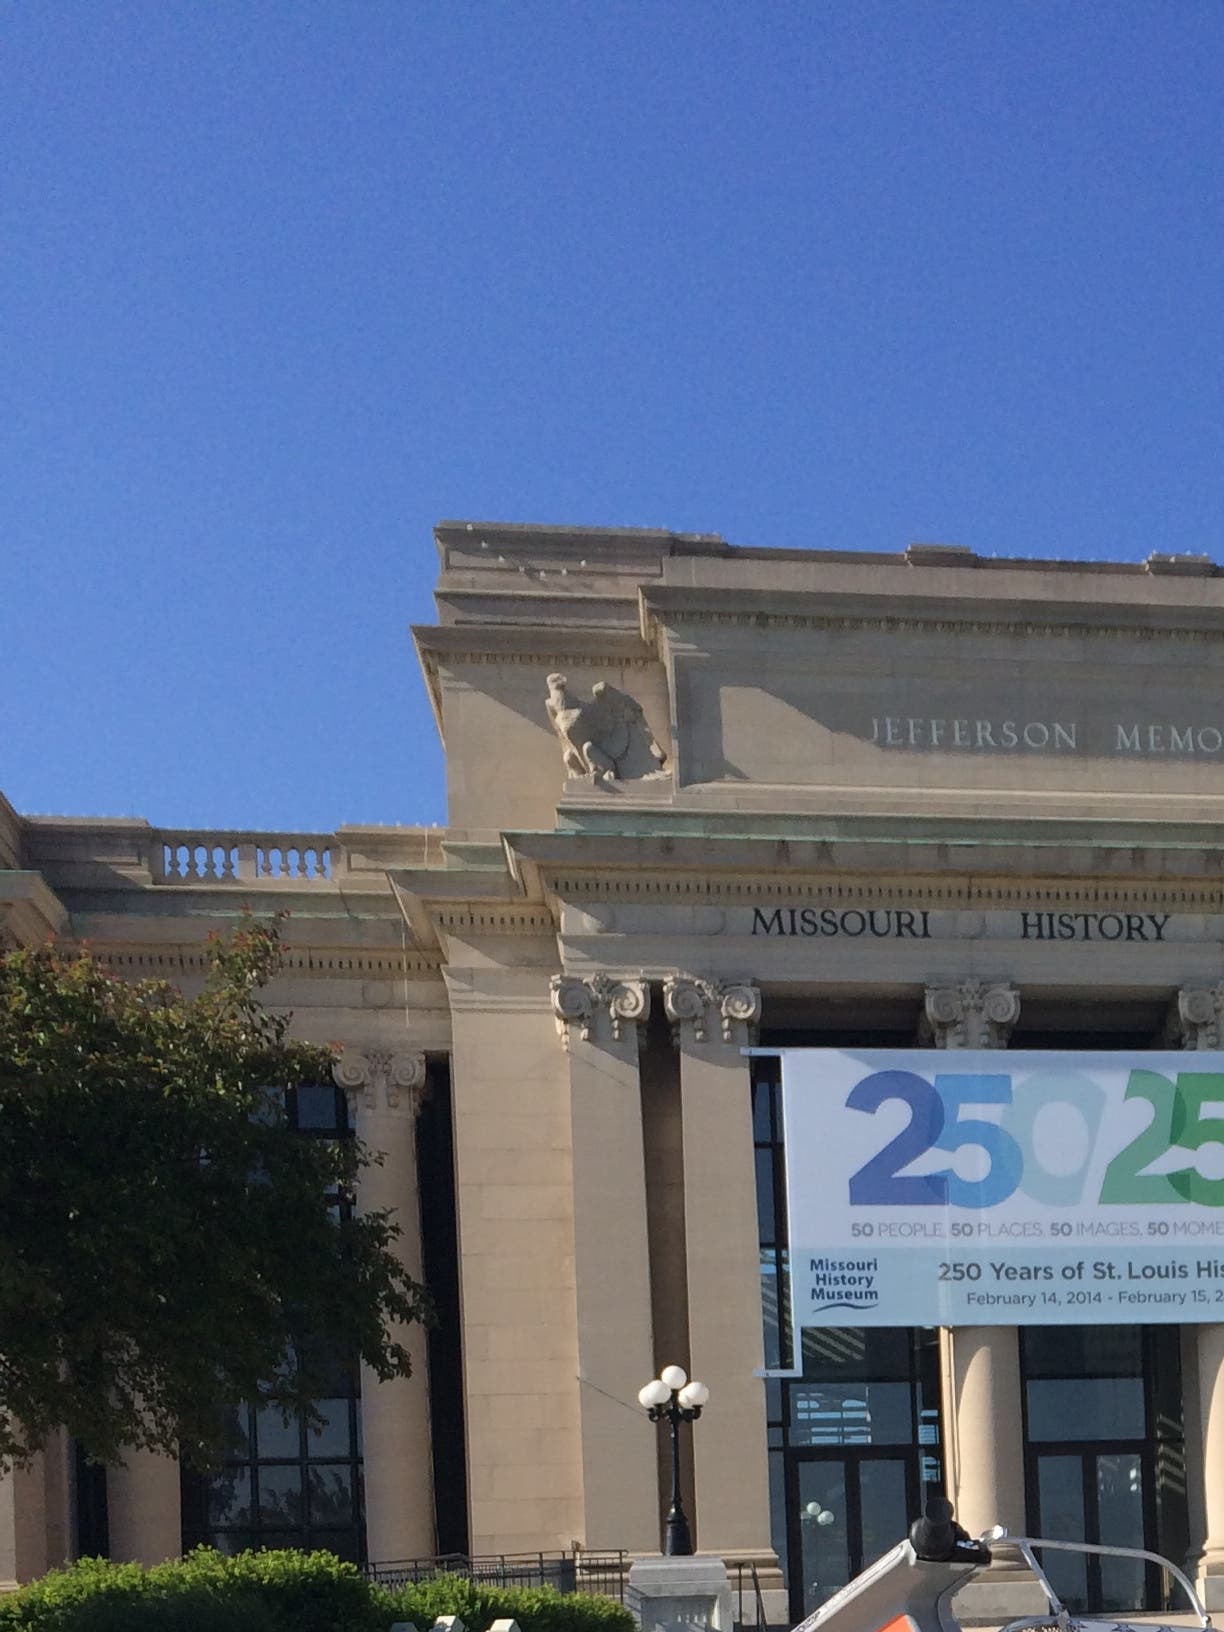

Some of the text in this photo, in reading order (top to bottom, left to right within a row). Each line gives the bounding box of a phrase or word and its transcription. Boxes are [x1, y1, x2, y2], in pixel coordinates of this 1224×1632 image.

[871, 716, 1078, 749] JEFFERSON
[751, 907, 933, 938] MISSOURI
[1020, 911, 1171, 942] HISTORY
[851, 1222, 874, 1238] 50
[951, 1222, 974, 1238] 50
[1050, 1221, 1073, 1237] 50
[1147, 1221, 1170, 1236] 50
[809, 1257, 878, 1272] Missouri
[938, 1261, 982, 1281] 250
[989, 1261, 1054, 1281] Years
[1061, 1260, 1085, 1281] of
[1092, 1260, 1122, 1280] St.
[1127, 1259, 1189, 1280] Louis
[815, 1272, 874, 1288] History
[810, 1287, 879, 1300] Museum
[967, 1291, 1036, 1307] February
[1041, 1291, 1063, 1306] 14,
[1066, 1290, 1103, 1305] 2014
[1118, 1289, 1187, 1306] February
[1191, 1289, 1211, 1305] 15,
